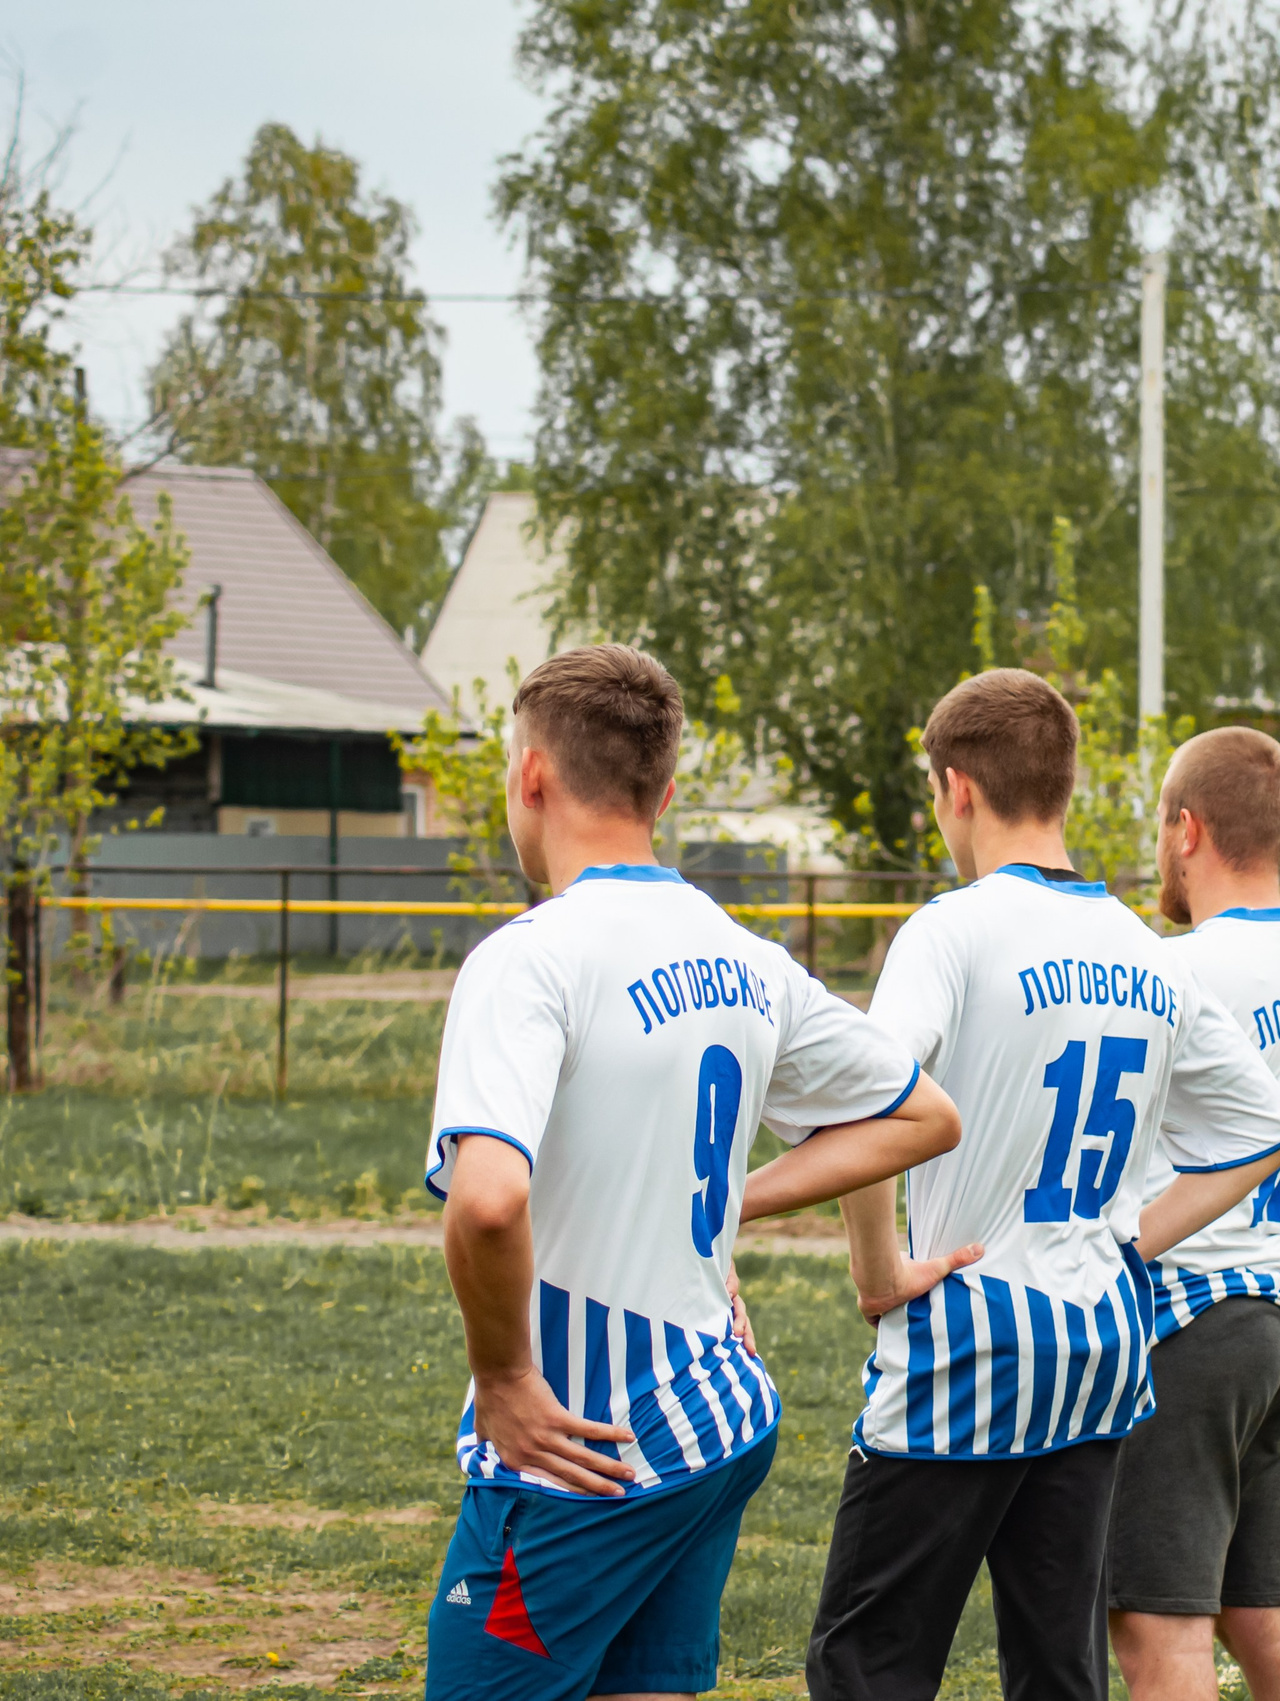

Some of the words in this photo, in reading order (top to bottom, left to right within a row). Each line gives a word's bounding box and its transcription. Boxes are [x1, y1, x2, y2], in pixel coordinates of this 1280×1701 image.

[627, 957, 774, 1035] ЛОГОВСКОЕ
[1018, 958, 1178, 1028] ЛОГОВСКОЕ
[691, 1044, 742, 1258] 9
[1024, 1035, 1148, 1223] 15
[446, 1593, 472, 1605] adidas
